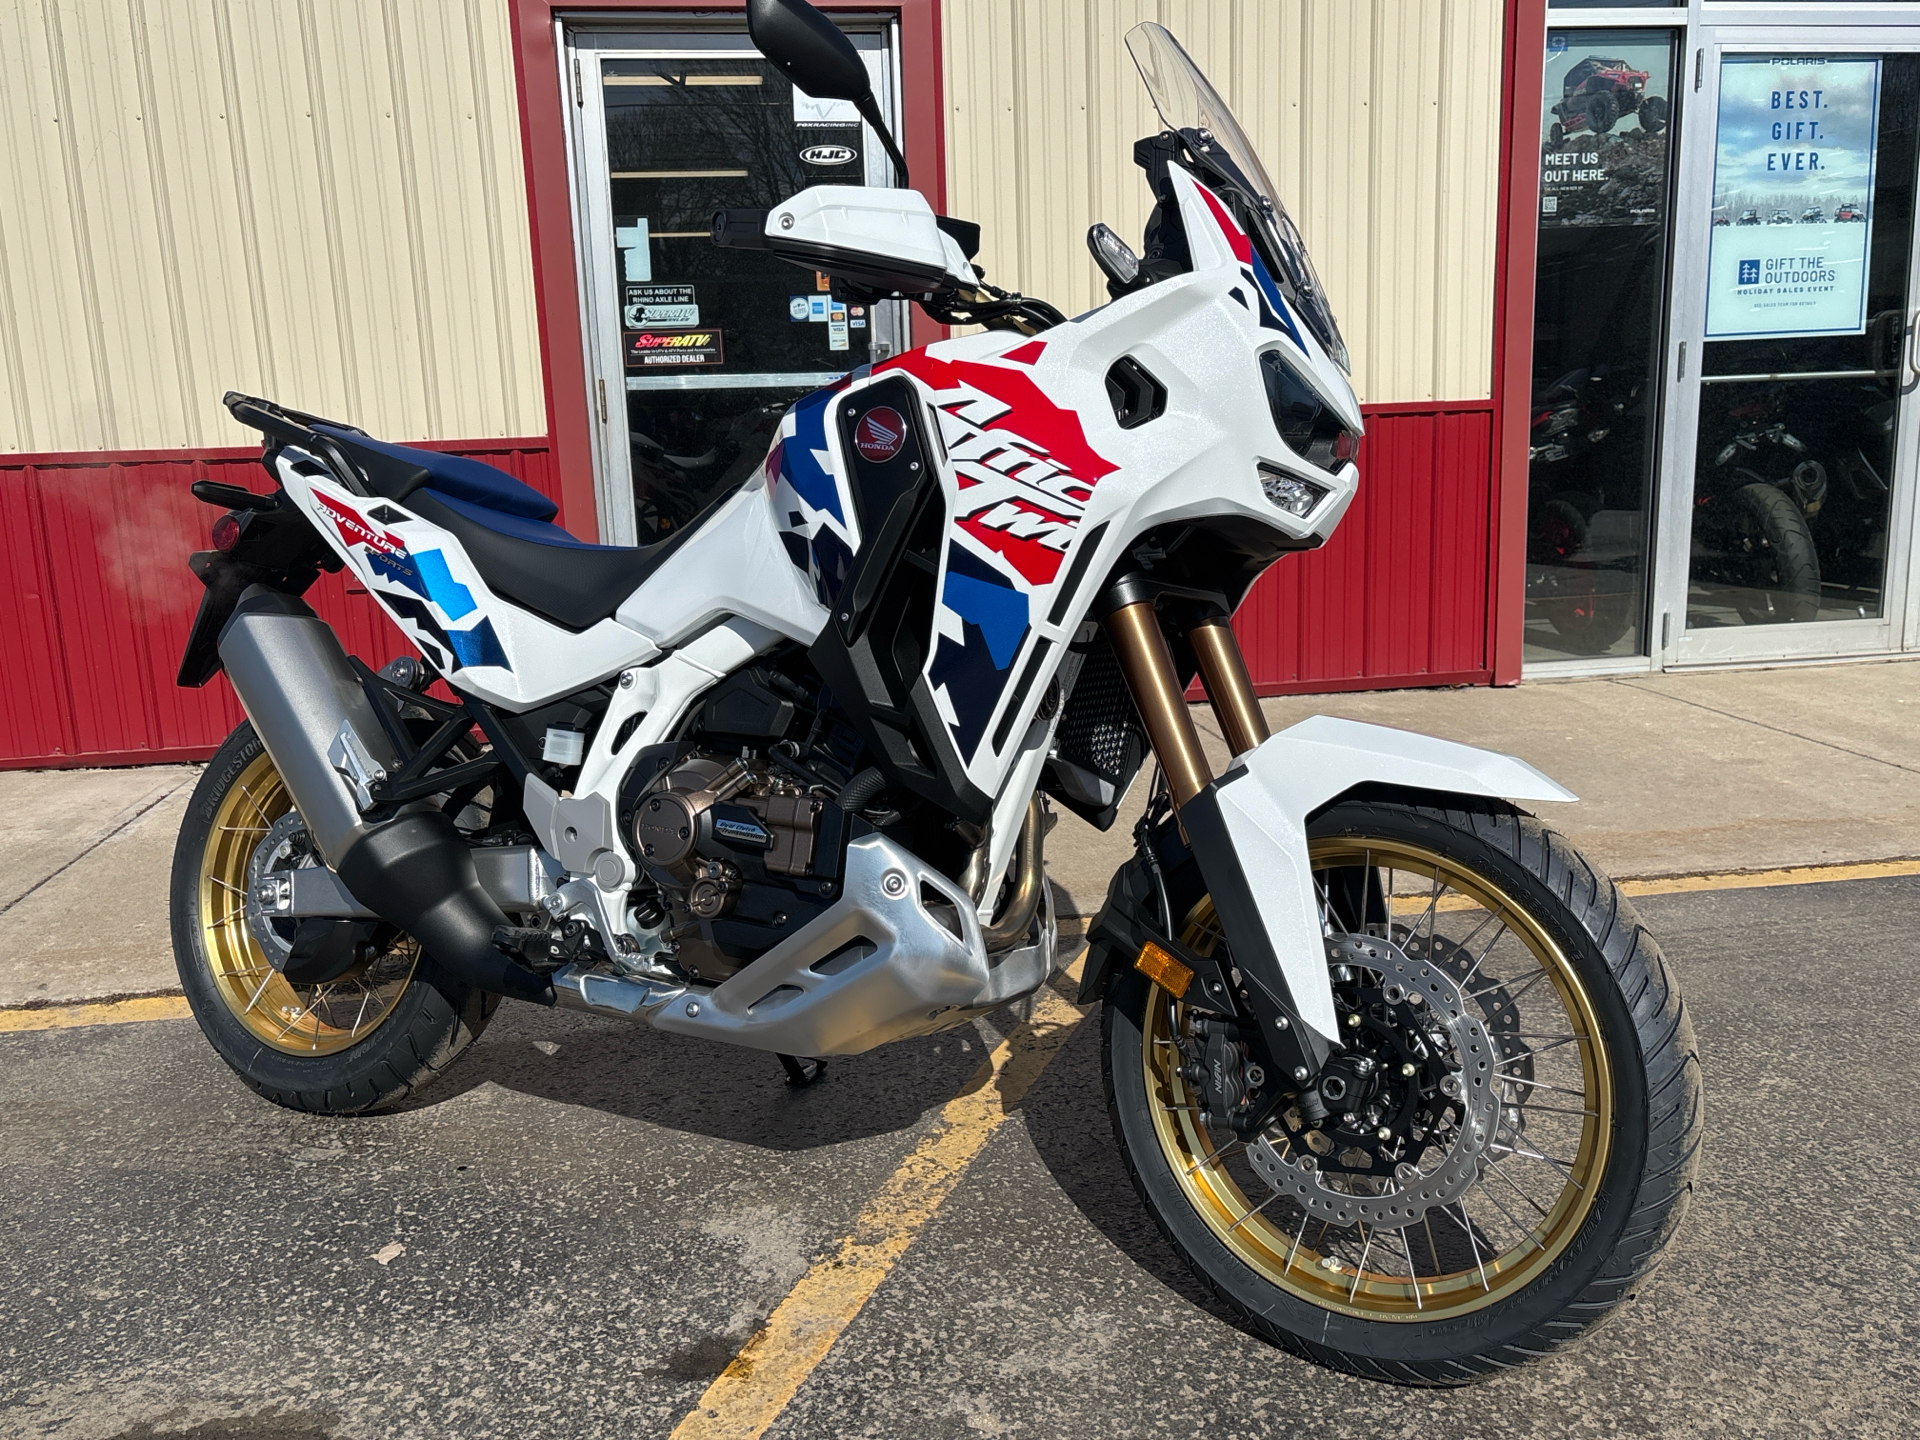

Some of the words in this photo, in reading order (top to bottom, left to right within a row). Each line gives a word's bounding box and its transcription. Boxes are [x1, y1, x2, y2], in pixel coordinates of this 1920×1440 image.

[1772, 57, 1826, 65] POLARIS
[1771, 90, 1828, 109] BEST.
[1771, 121, 1824, 140] GIFT.
[809, 150, 847, 159] HJC
[1545, 152, 1579, 165] MEET
[1581, 152, 1599, 164] US
[1767, 152, 1825, 171] EVER.
[1544, 170, 1570, 182] OUT
[1572, 169, 1609, 181] HERE.
[1766, 258, 1795, 270] GIFT
[1799, 257, 1824, 269] THE
[1765, 270, 1835, 284] OUTDOORS
[644, 356, 681, 364] AUTHORIZED
[682, 354, 704, 363] DEALER
[860, 442, 895, 451] HONDA
[933, 379, 1093, 511] Afric
[951, 460, 1086, 554] Twi
[317, 503, 408, 560] ADVENTURE
[202, 738, 262, 819] BRIDGESTON
